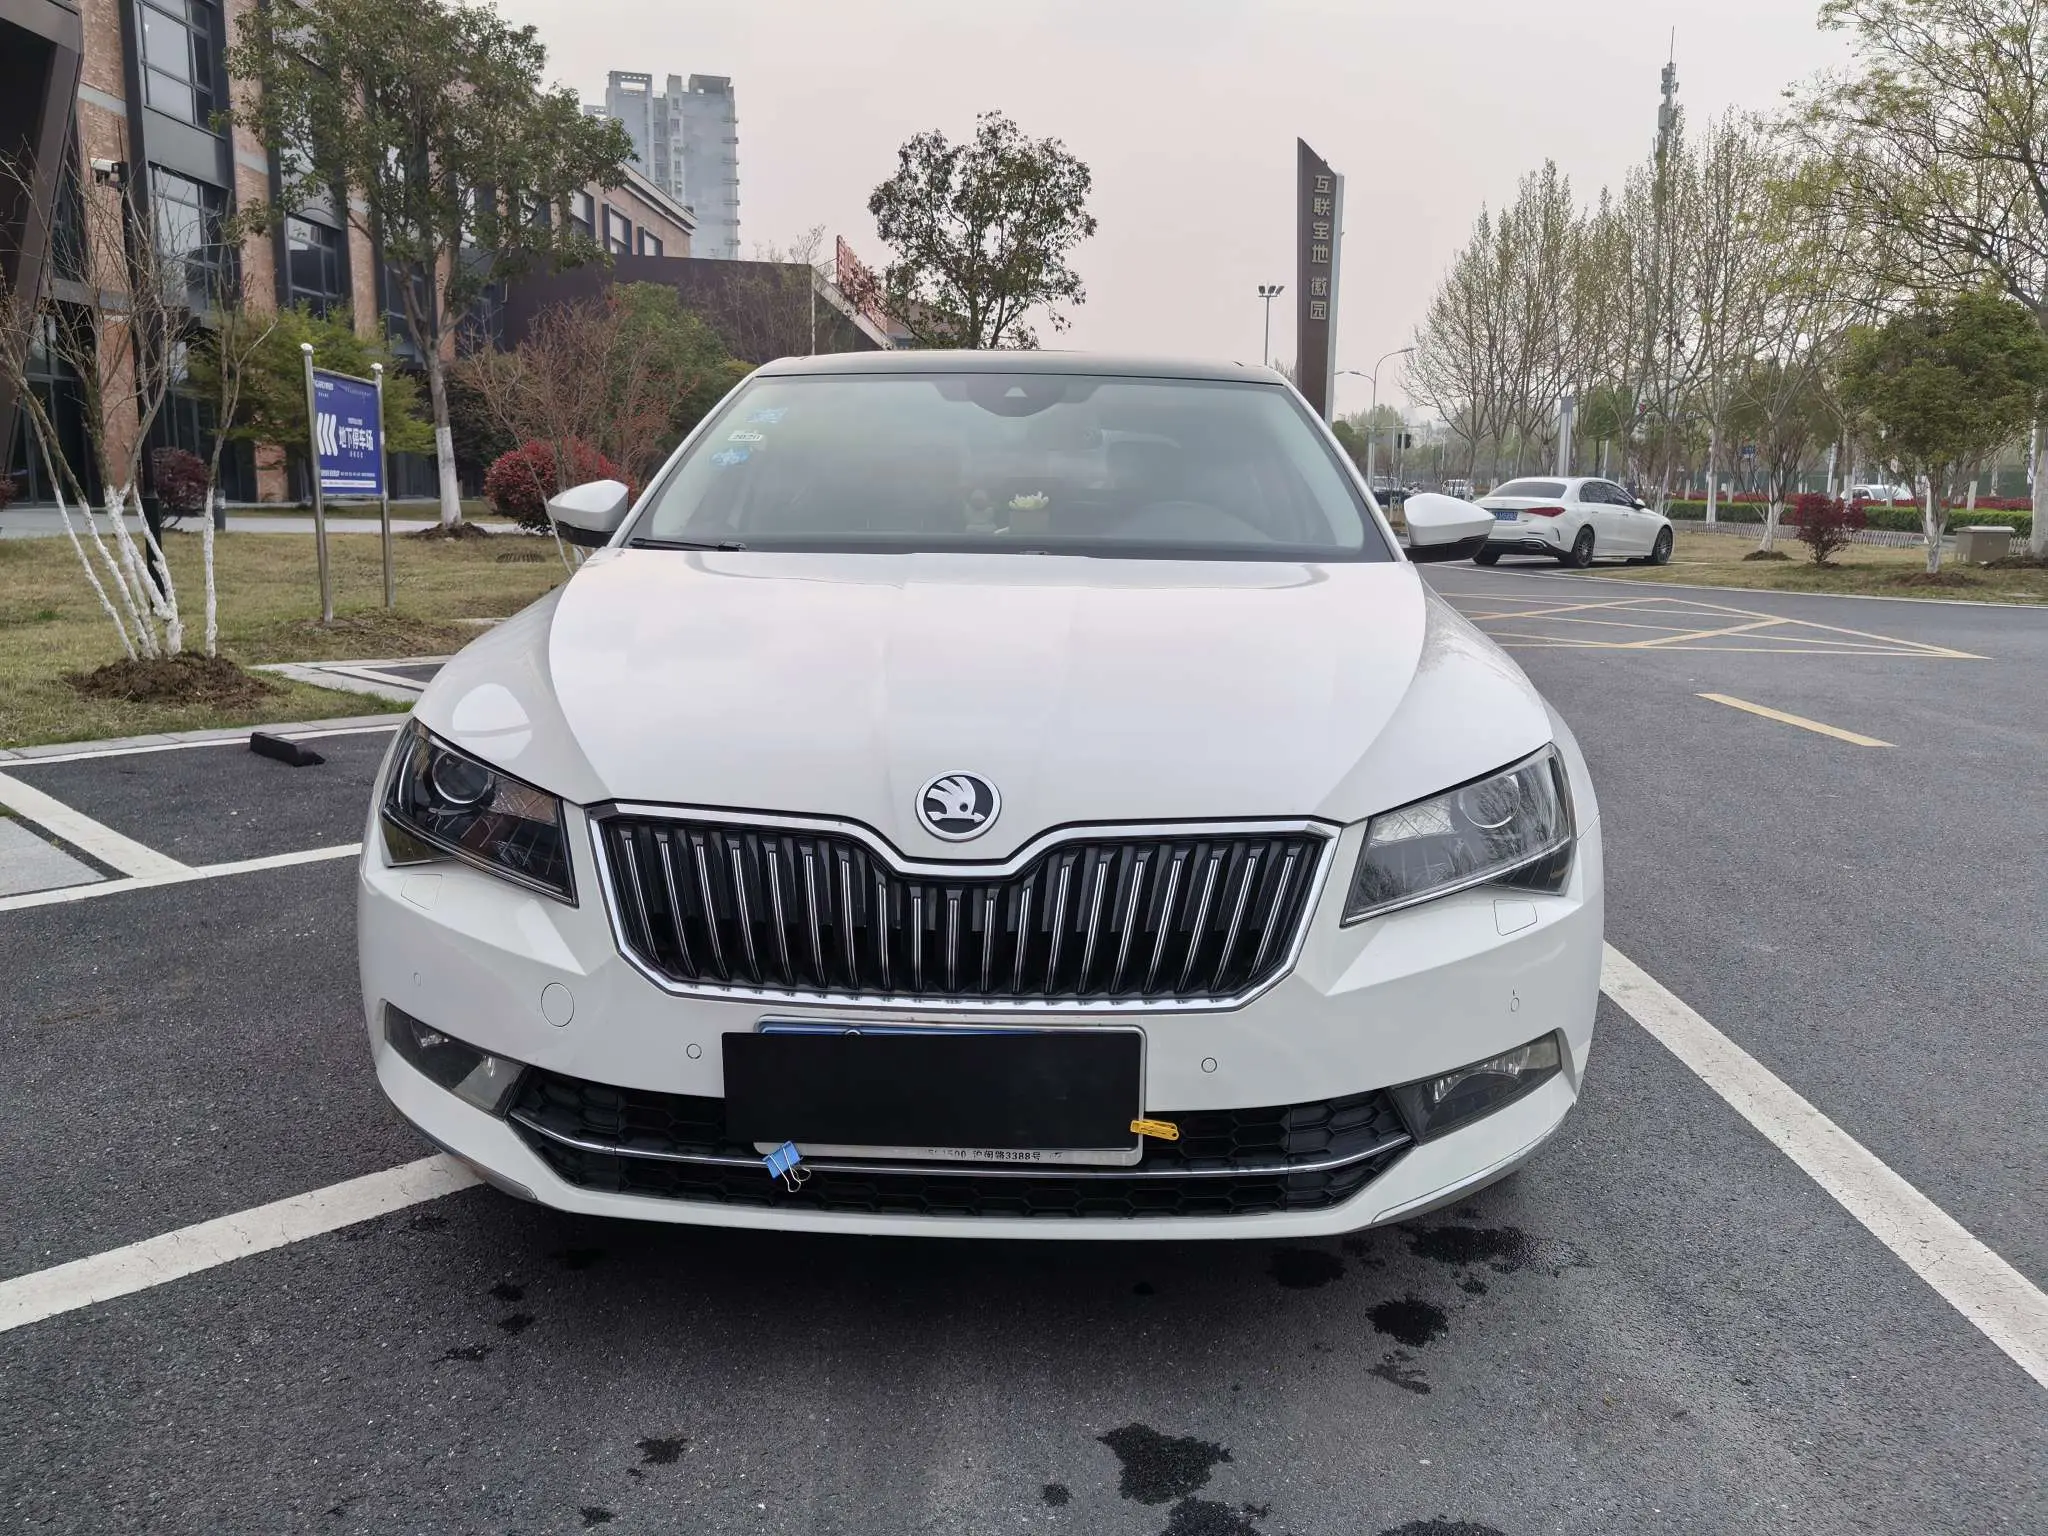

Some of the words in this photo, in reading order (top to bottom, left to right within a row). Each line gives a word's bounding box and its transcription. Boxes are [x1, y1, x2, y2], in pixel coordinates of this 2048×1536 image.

[1312, 174, 1331, 264] 互联宝地
[1310, 276, 1327, 320] 徽园
[339, 426, 374, 451] 地下停车场
